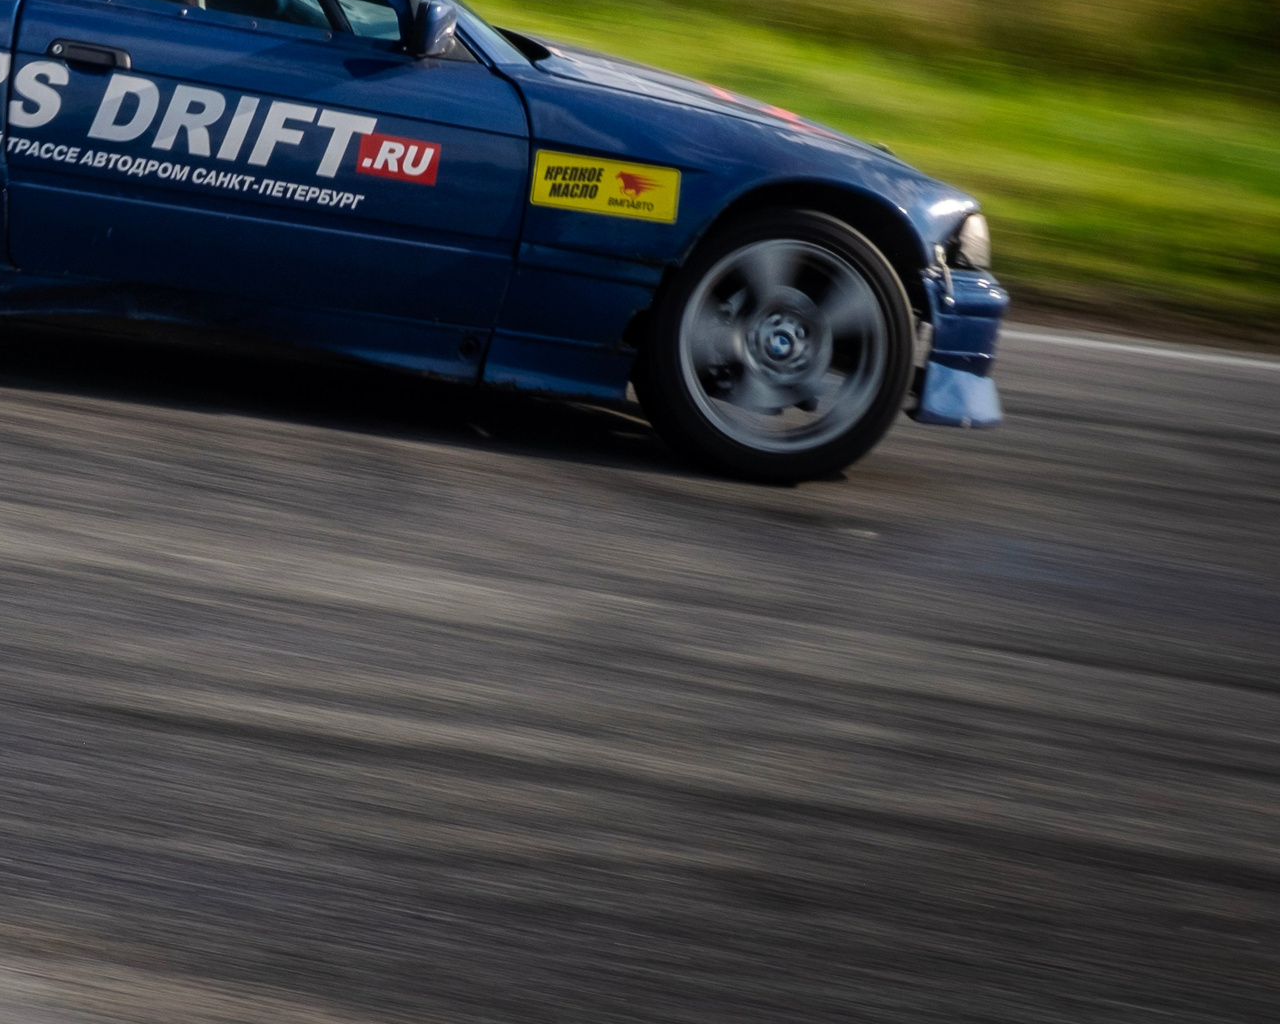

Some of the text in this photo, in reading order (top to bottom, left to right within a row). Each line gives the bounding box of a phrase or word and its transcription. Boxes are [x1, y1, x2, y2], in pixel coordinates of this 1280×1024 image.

[86, 73, 378, 178] DRIFT
[6, 137, 81, 163] ТРАССЕ
[80, 149, 191, 181] АВТОДРОМ
[192, 167, 365, 210] САНКТ-ПЕТЕРБУРГ
[544, 165, 605, 183] КРЕПКОЕ
[549, 183, 599, 199] МАСЛО
